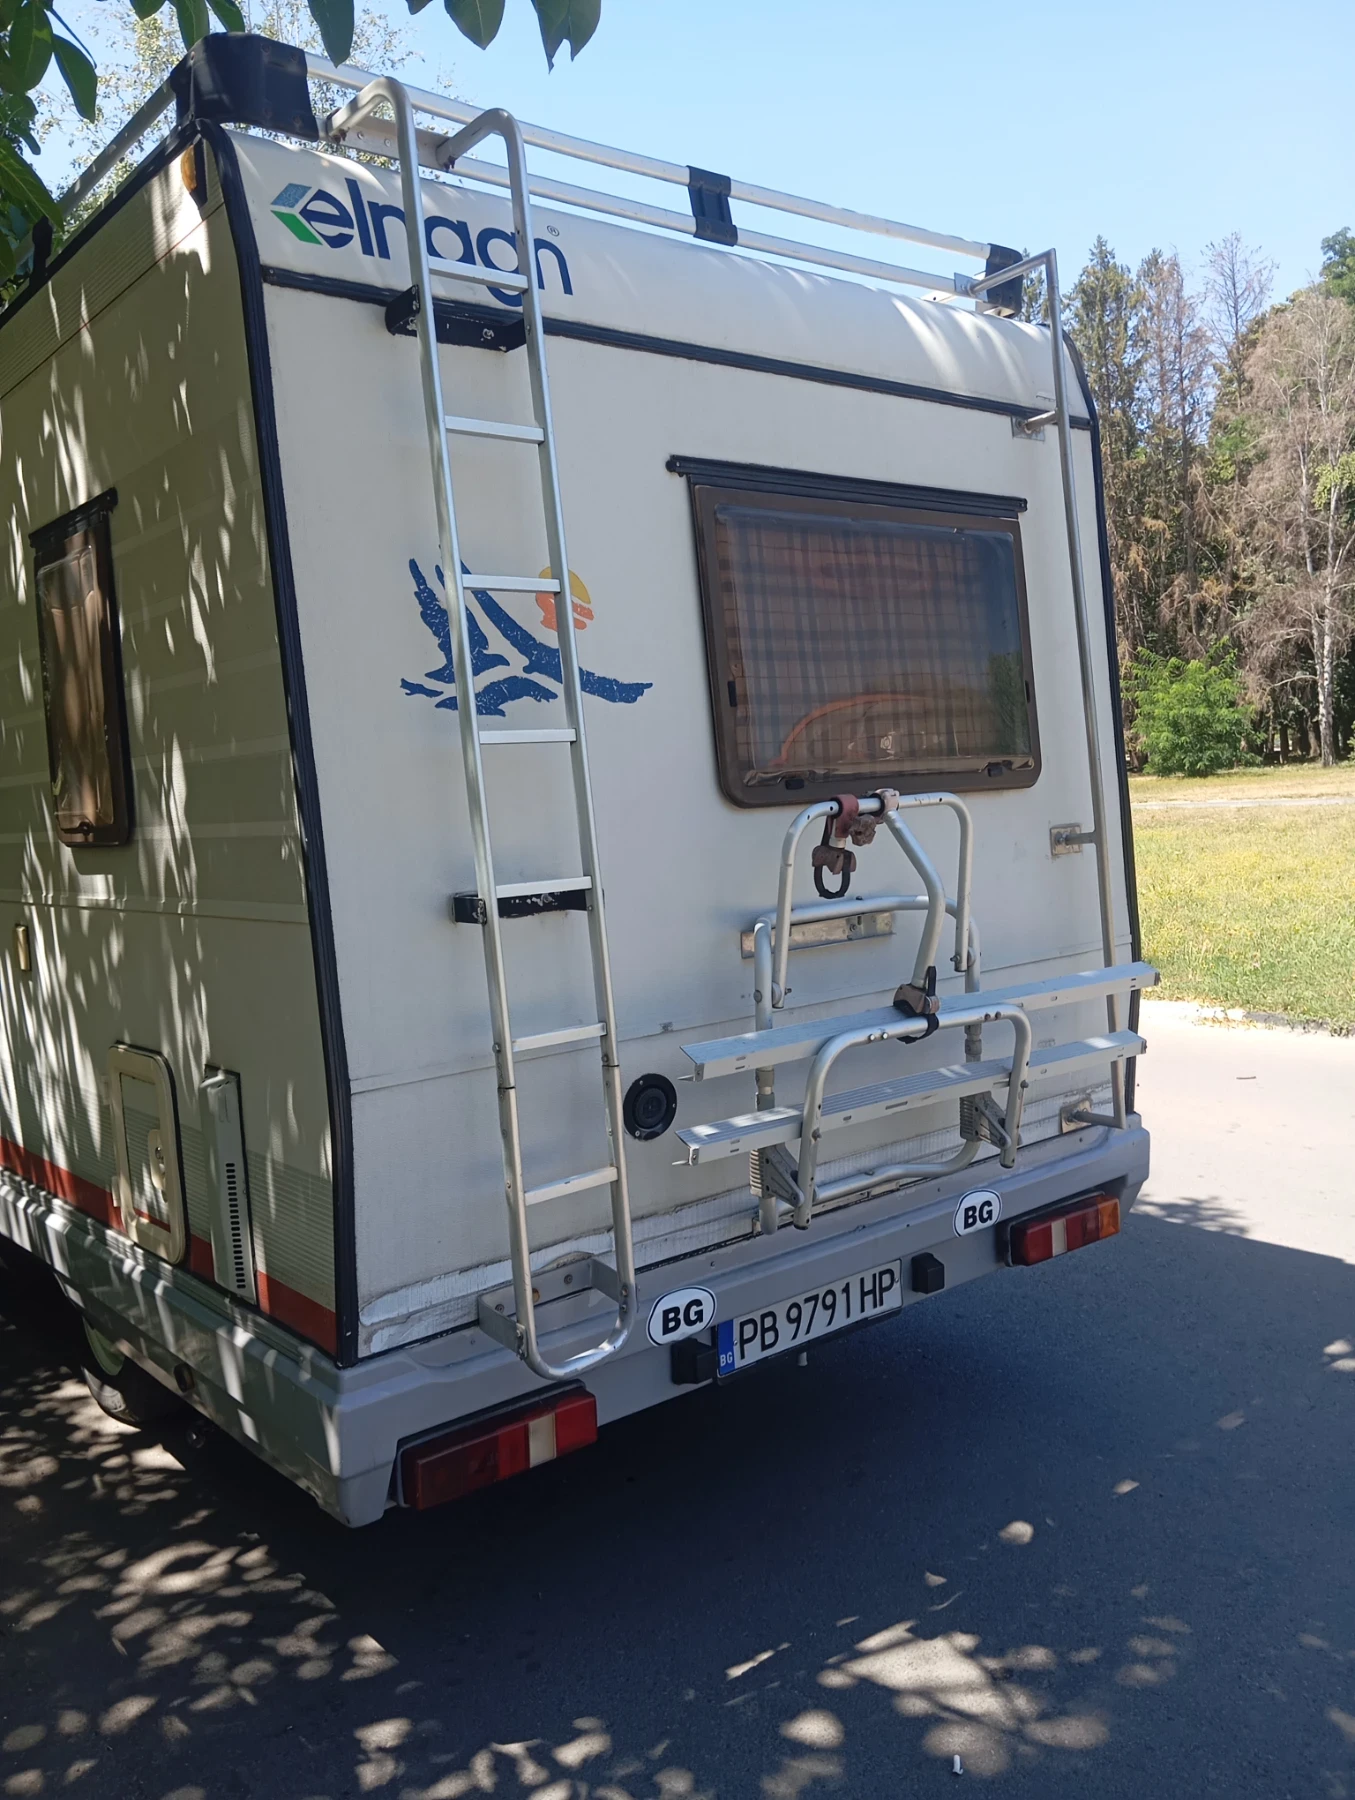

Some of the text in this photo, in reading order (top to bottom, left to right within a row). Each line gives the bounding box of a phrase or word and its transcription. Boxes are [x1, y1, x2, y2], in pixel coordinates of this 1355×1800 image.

[963, 1200, 993, 1230] BG
[662, 1299, 704, 1334] BG
[740, 1268, 895, 1360] PB 9791 HP
[720, 1352, 733, 1367] BG
